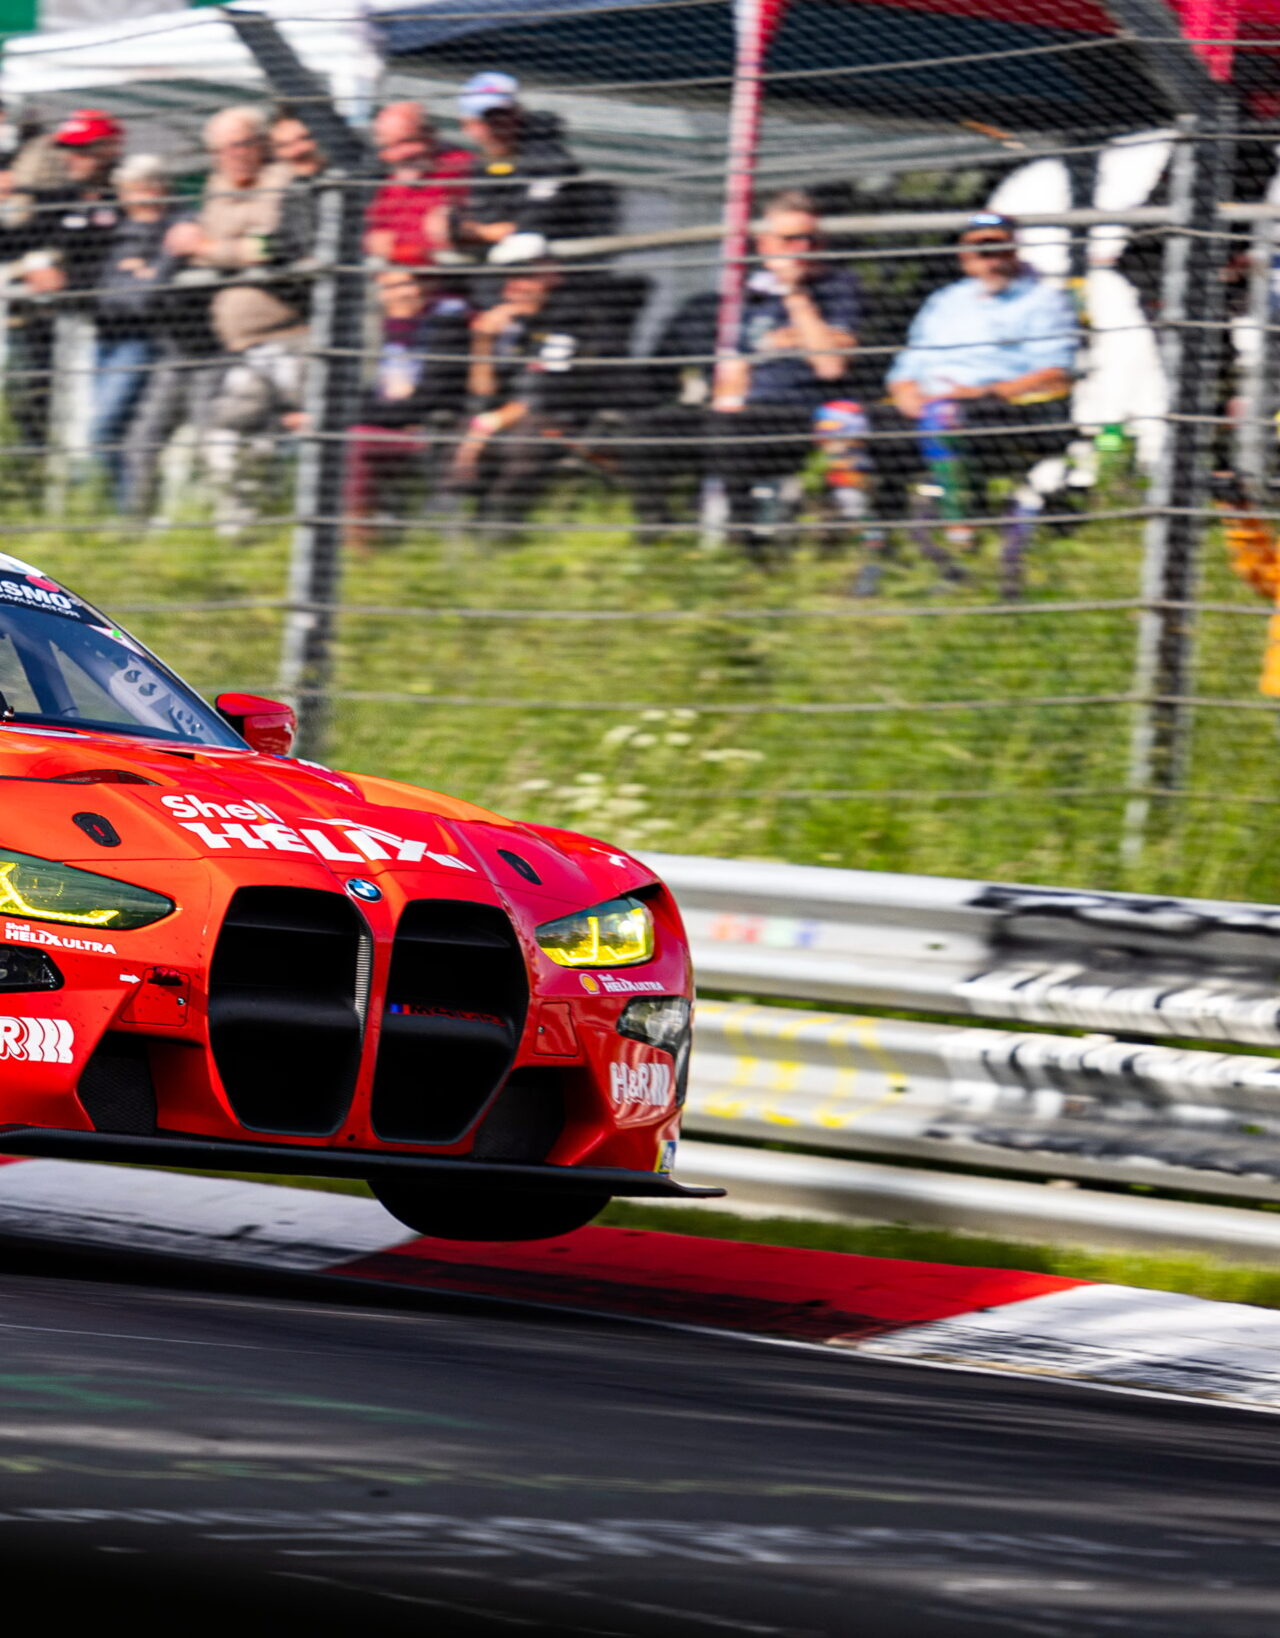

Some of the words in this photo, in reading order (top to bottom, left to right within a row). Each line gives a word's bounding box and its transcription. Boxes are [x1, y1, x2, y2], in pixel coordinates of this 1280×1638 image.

[160, 794, 284, 823] Shell
[177, 816, 477, 873] HELIX
[5, 929, 63, 947] HELIX
[62, 938, 117, 955] ULTRA
